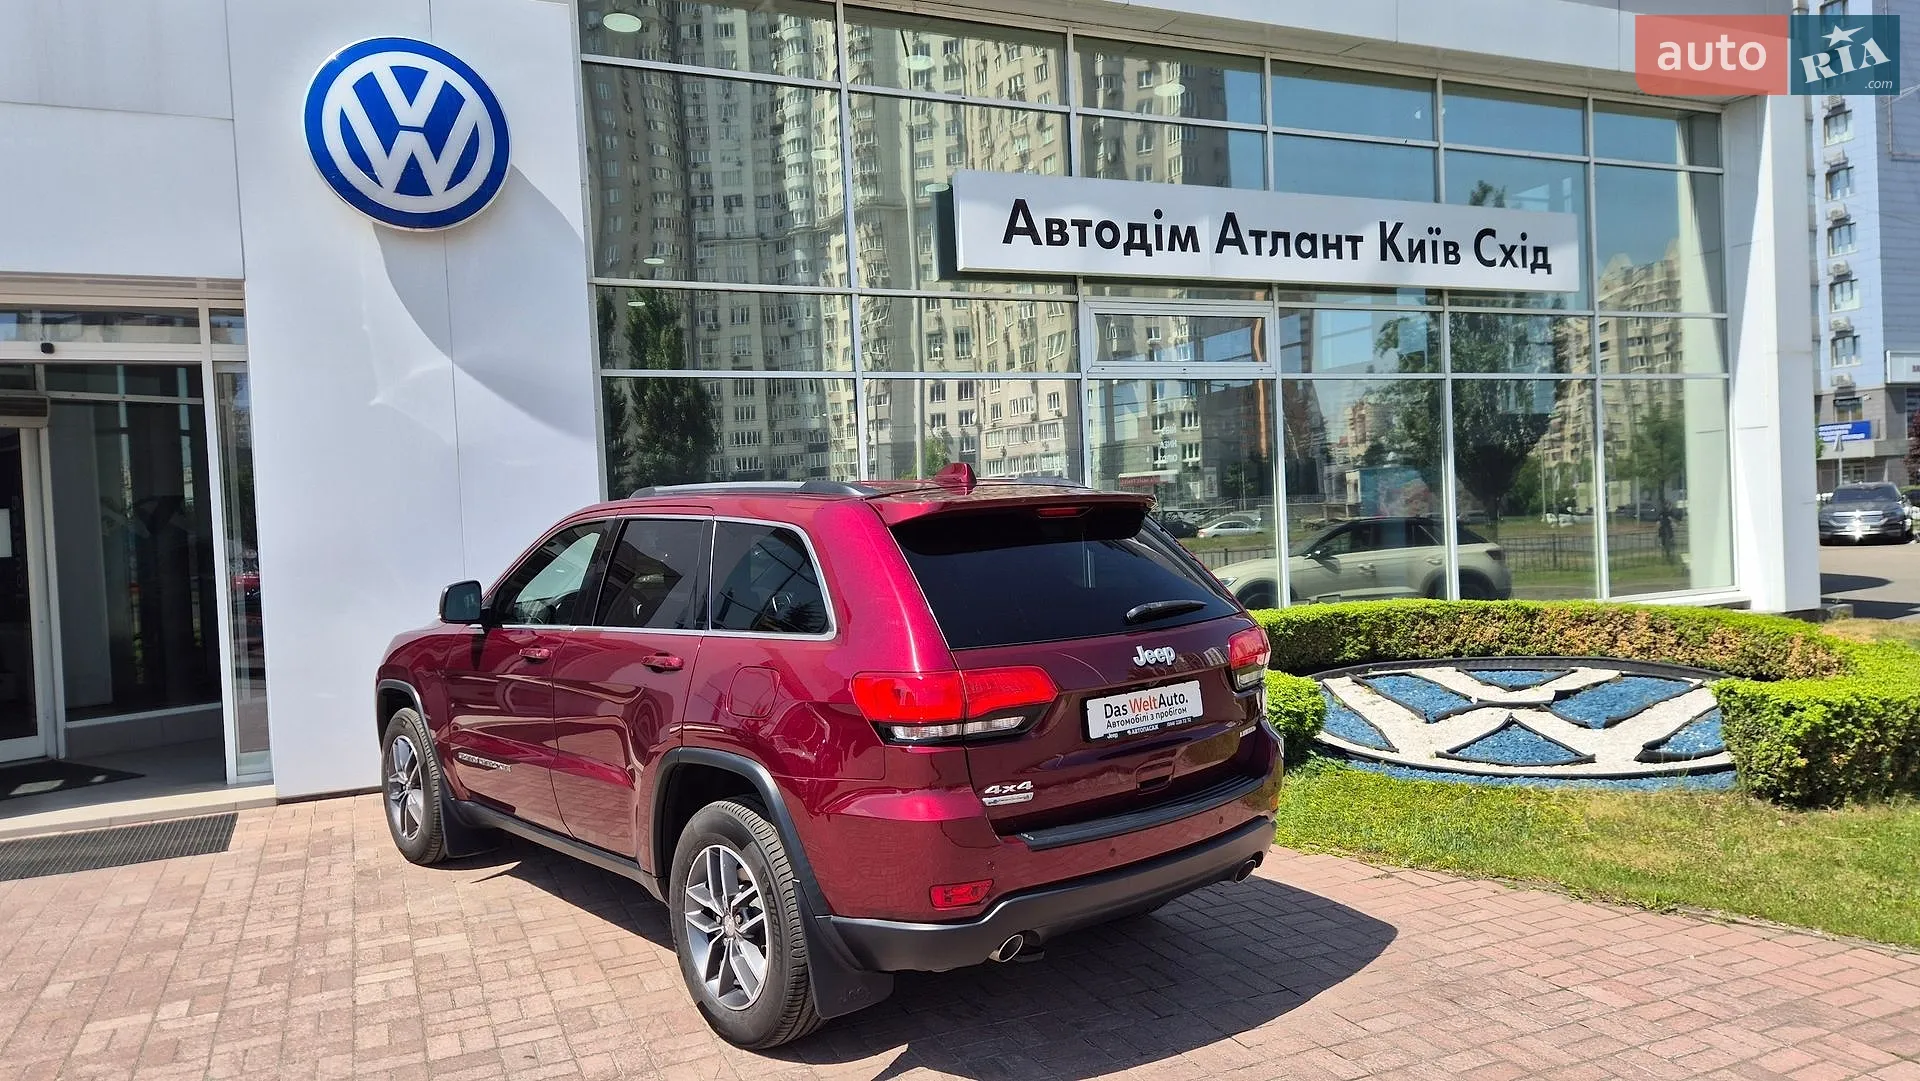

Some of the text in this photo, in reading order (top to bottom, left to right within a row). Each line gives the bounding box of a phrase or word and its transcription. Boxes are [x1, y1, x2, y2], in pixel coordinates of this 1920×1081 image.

[1003, 198, 1553, 275] Автодім Атлант Київ Схід
[1133, 645, 1176, 667] Jeep
[1104, 703, 1128, 719] Das
[1106, 712, 1149, 729] Автомобілі
[1155, 706, 1187, 721] пробігом
[984, 780, 1034, 795] 4x4
